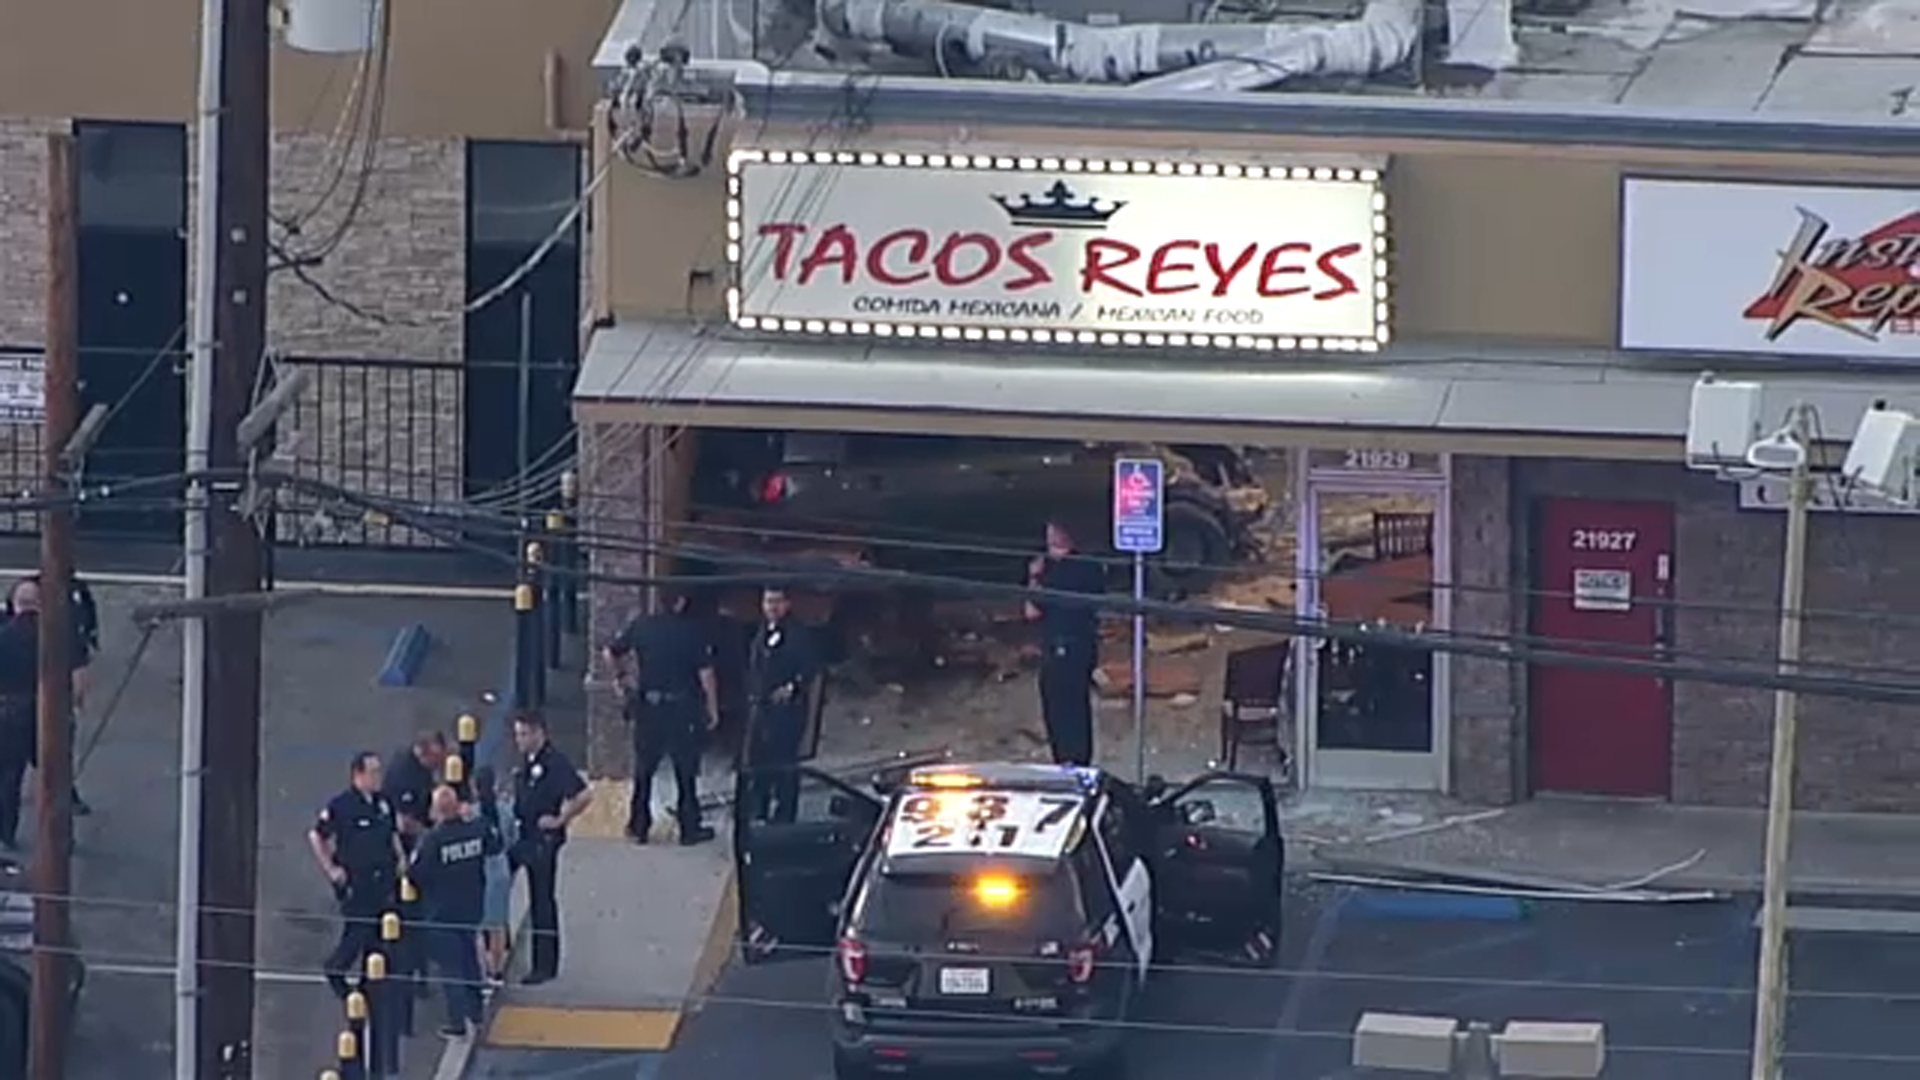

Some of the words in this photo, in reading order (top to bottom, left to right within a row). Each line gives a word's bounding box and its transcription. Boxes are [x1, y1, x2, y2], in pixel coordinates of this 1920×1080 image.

[758, 222, 1054, 291] TACOS
[1080, 237, 1362, 301] REYES
[853, 294, 942, 317] COMIDA
[948, 297, 1061, 319] MEXICANA
[1097, 305, 1196, 323] MEXICAN
[1203, 308, 1265, 325] FOOD
[1344, 449, 1411, 469] 21929
[1572, 529, 1637, 551] 21927
[440, 838, 483, 866] POLICE
